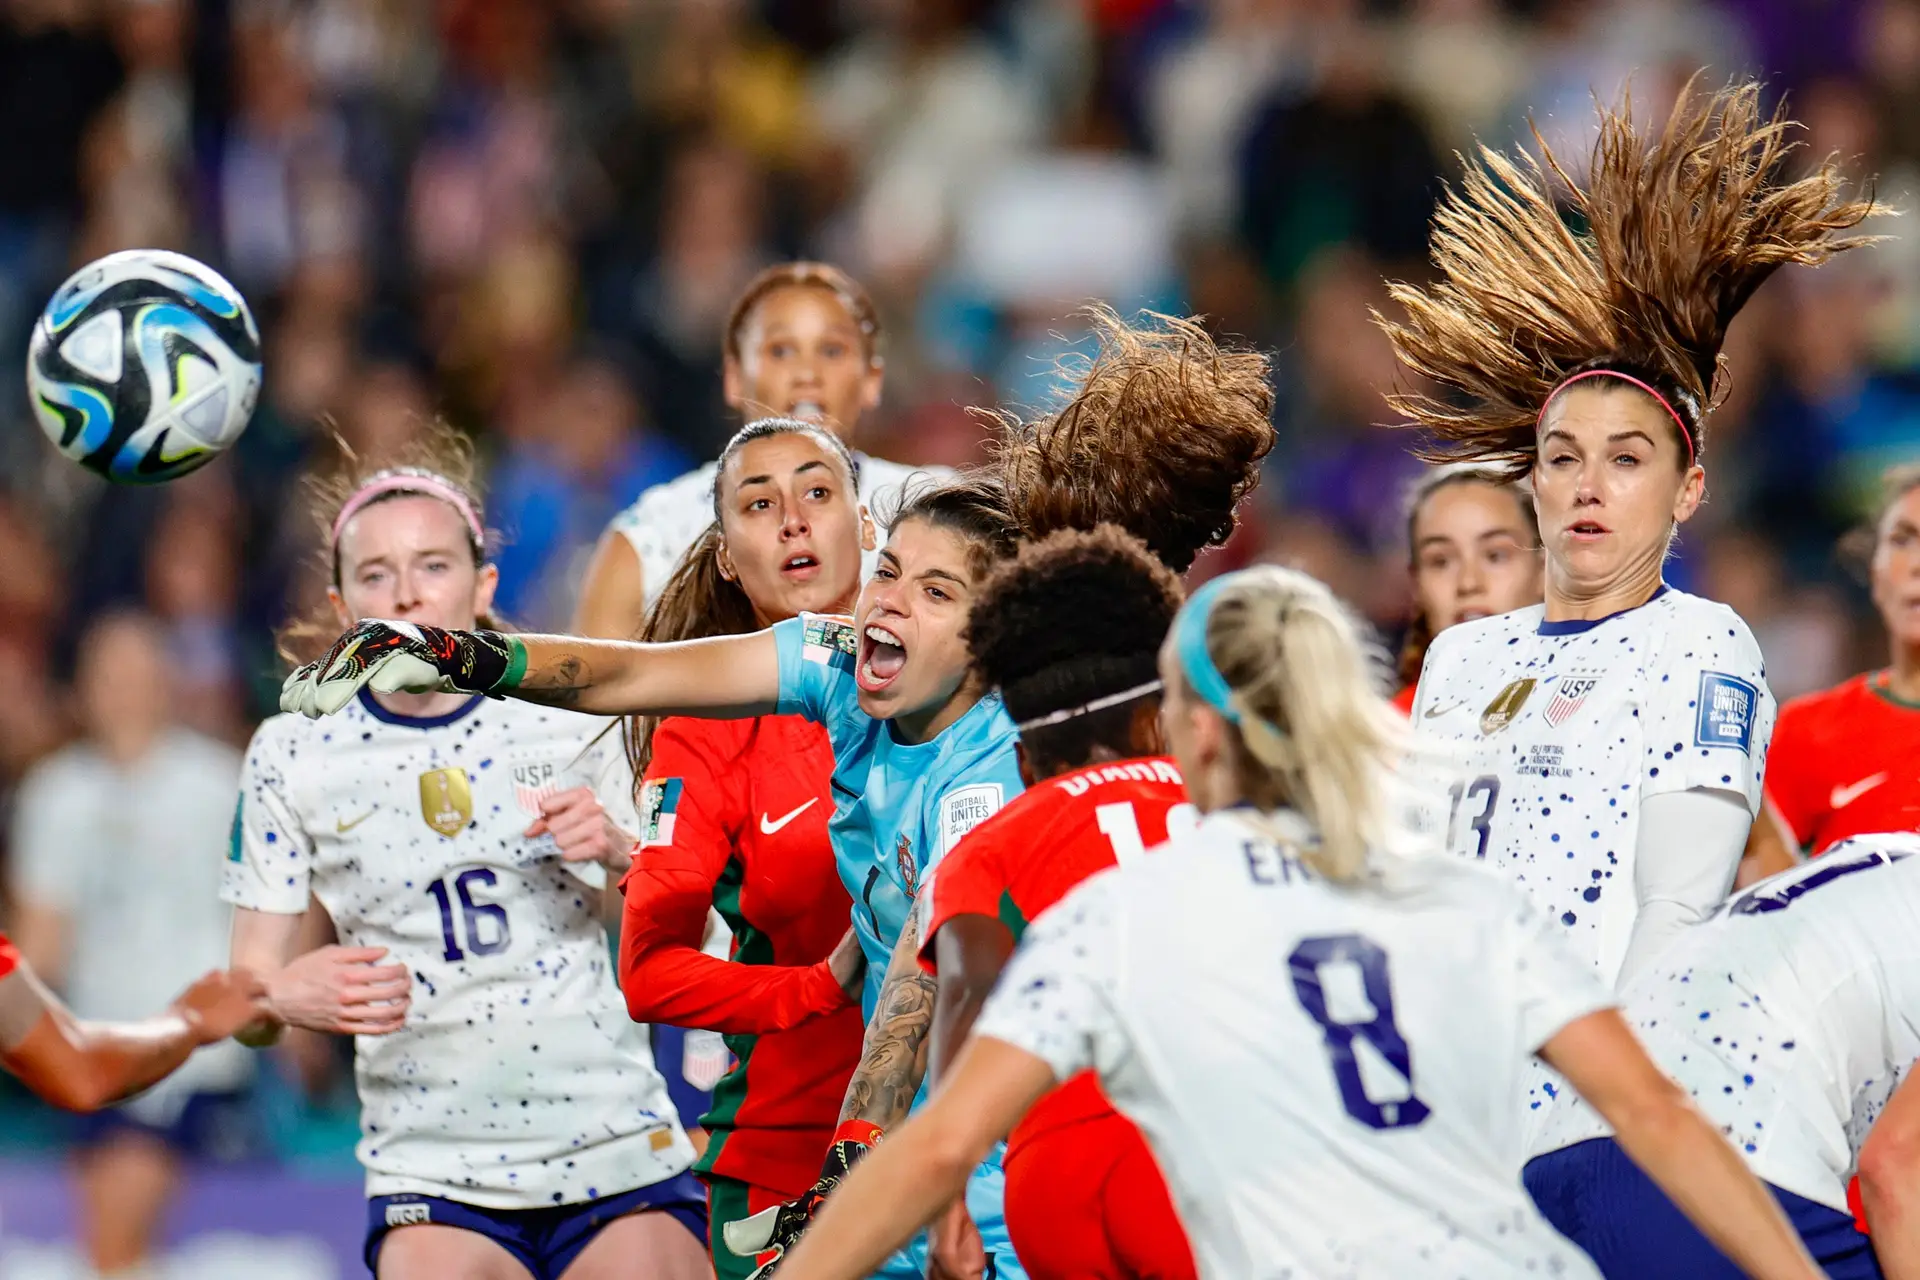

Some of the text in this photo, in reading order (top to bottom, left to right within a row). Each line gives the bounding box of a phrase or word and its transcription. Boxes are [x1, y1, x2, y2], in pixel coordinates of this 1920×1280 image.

[1561, 680, 1596, 698] USA
[1714, 684, 1748, 704] FOOTBALL
[1713, 695, 1748, 717] UNITES
[950, 795, 988, 810] FOOTBALL
[951, 805, 989, 823] UNITES
[1446, 775, 1501, 859] 13
[950, 822, 964, 836] the
[425, 868, 512, 962] 16
[1288, 935, 1432, 1130] 8
